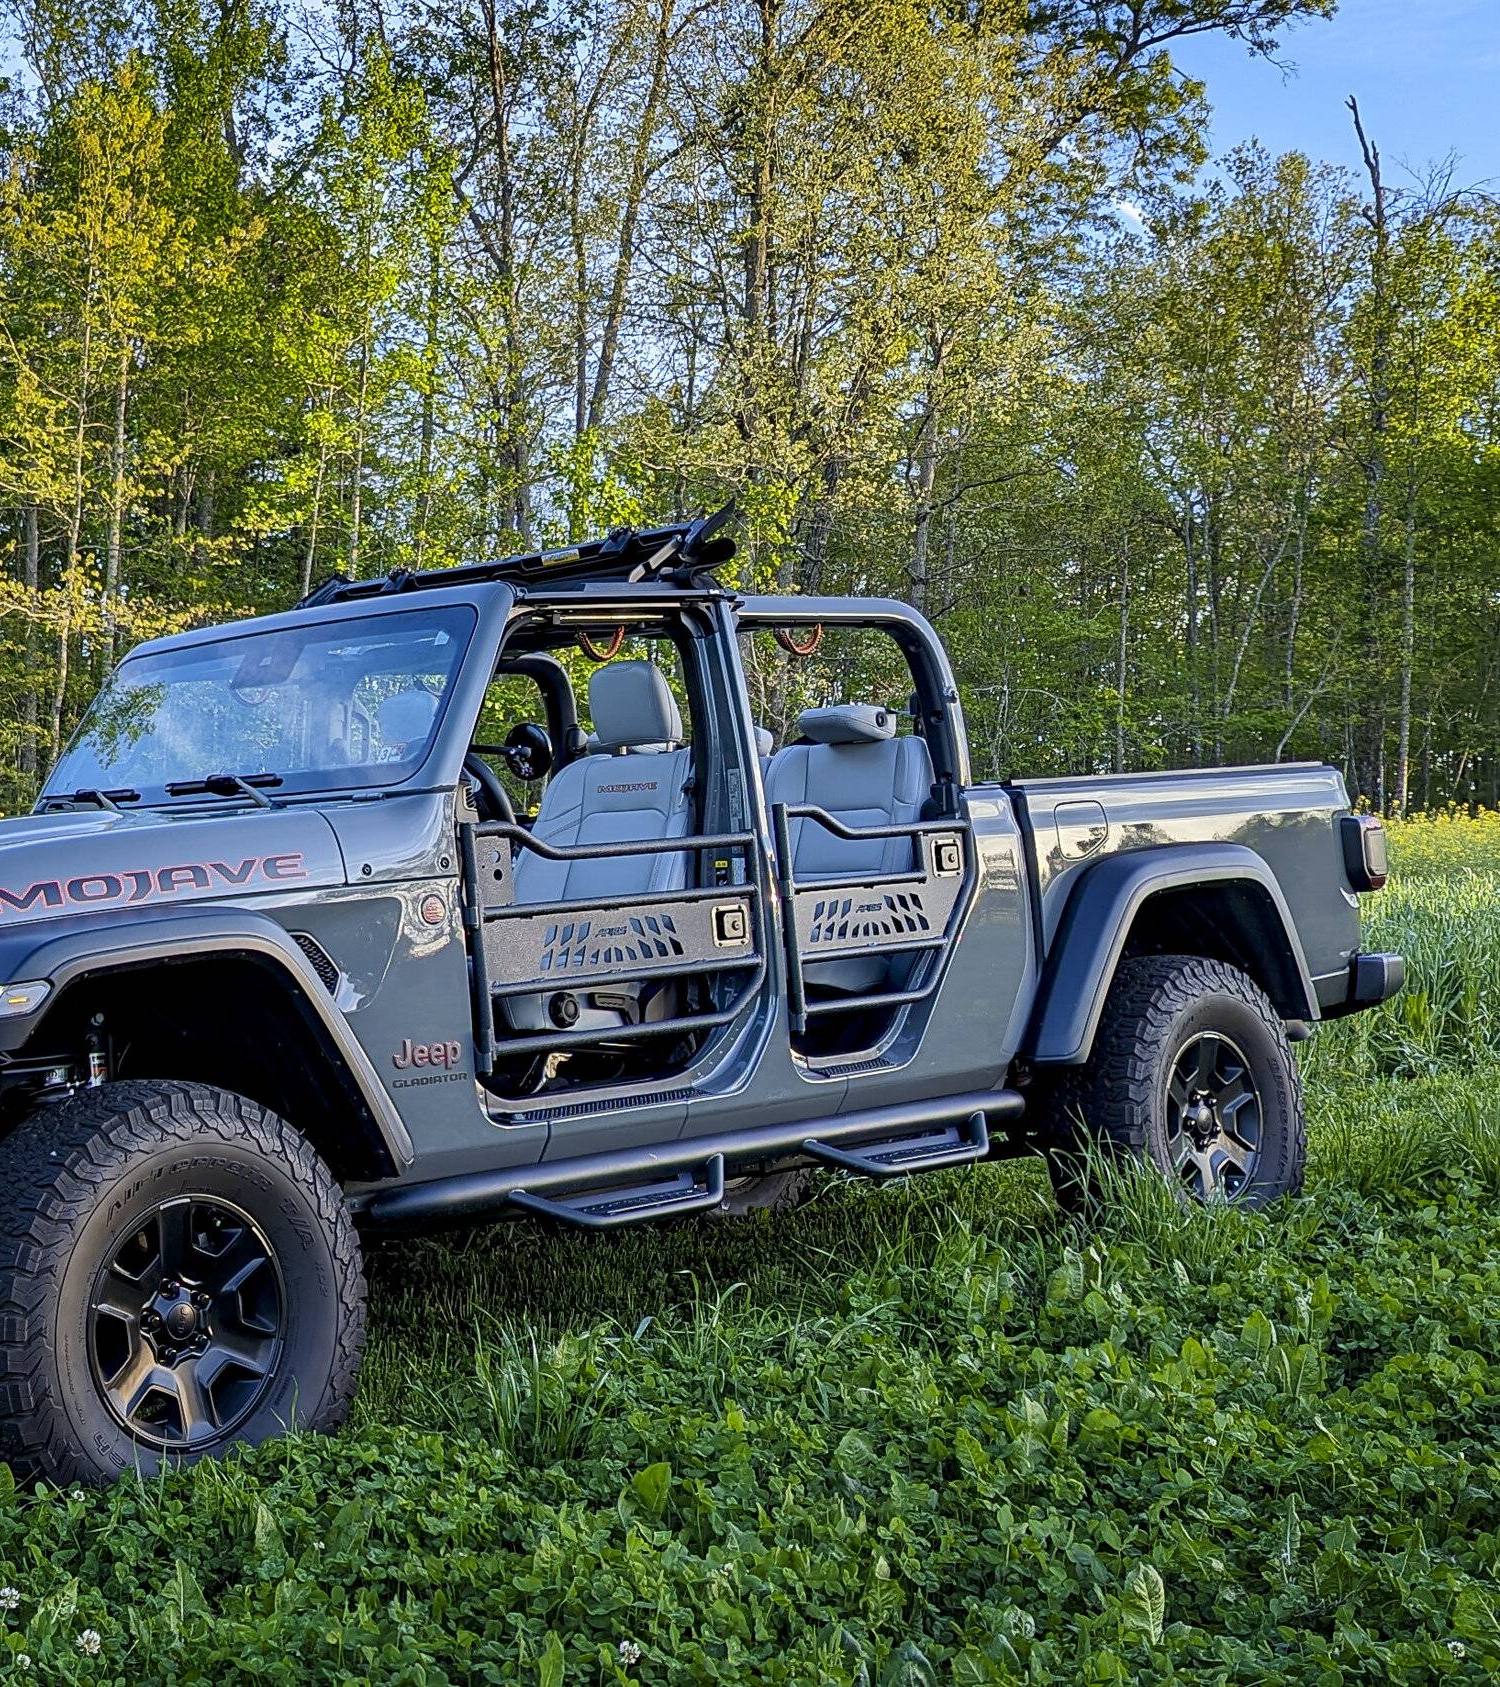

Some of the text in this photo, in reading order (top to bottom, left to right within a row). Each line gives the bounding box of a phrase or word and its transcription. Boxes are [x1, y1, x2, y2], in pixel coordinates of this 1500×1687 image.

[596, 782, 659, 794] MOJAVE
[392, 1038, 461, 1070] Jeep
[392, 1072, 468, 1089] GLADIATOR
